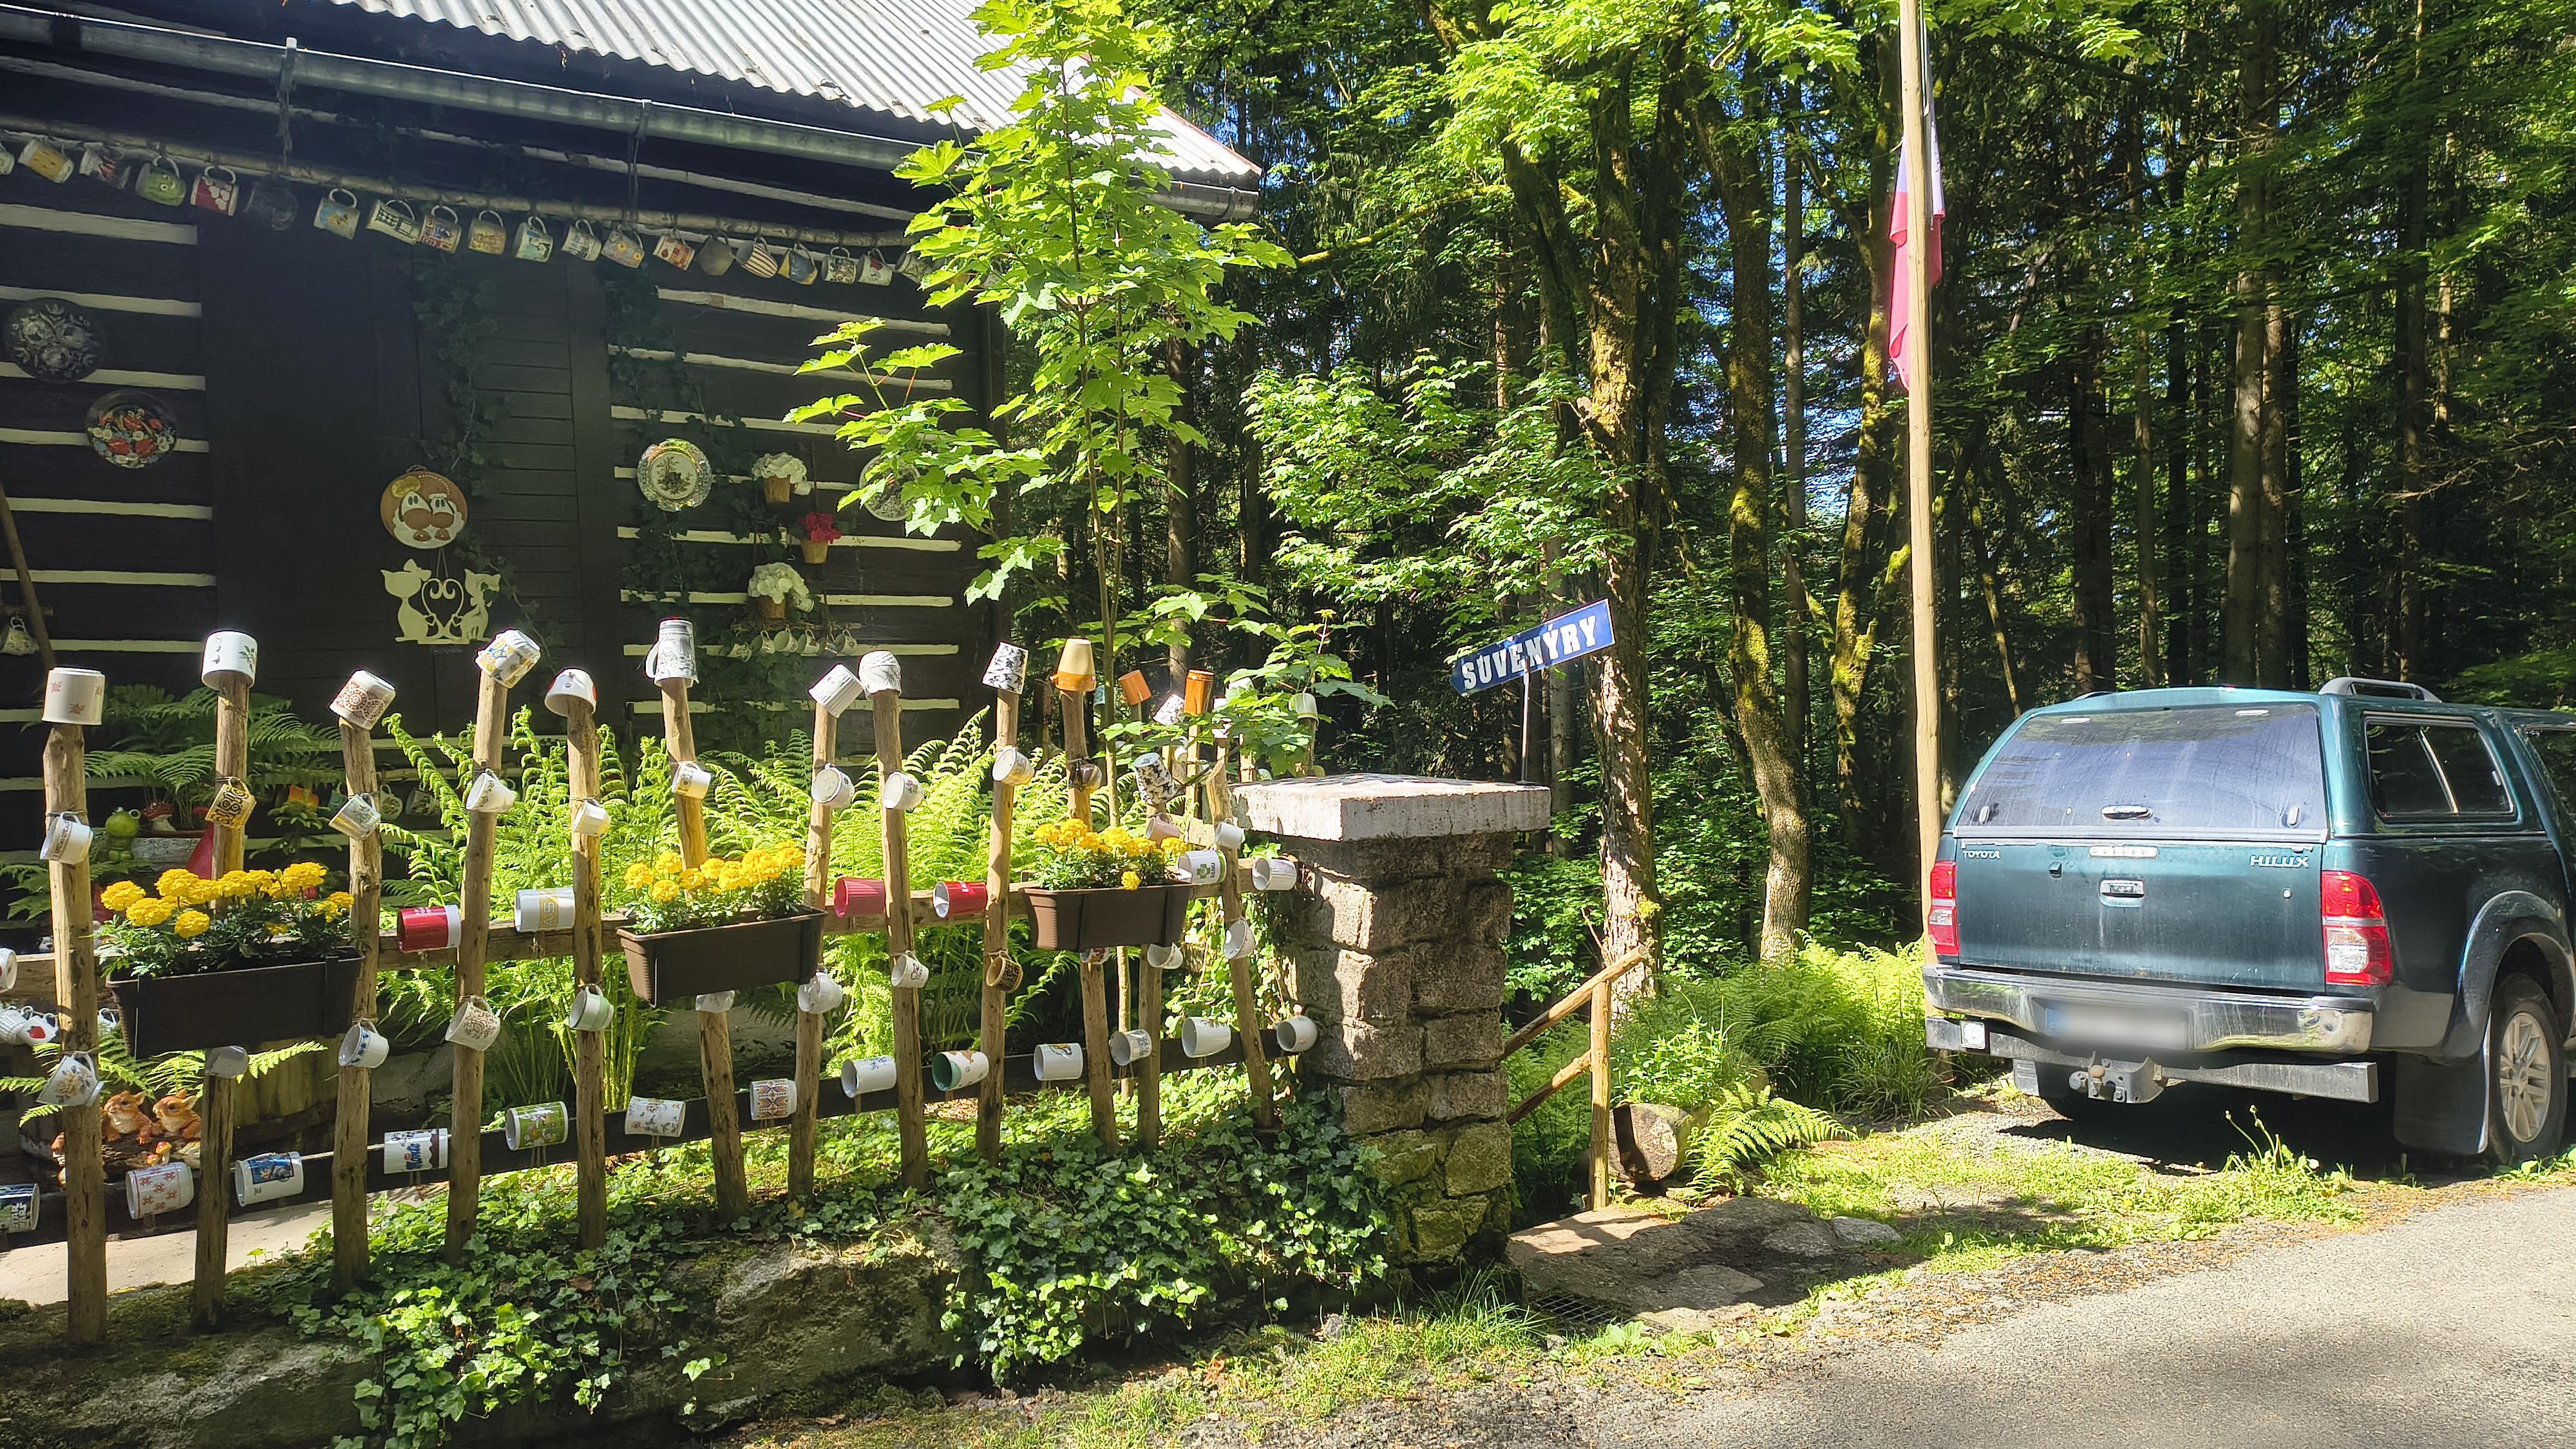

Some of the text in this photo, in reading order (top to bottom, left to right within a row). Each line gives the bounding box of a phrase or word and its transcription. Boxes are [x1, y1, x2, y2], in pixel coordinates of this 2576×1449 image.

[1461, 614, 1597, 690] SUVENÝRY
[1962, 849, 2001, 860] TOYOTA
[2249, 855, 2309, 869] HILUX
